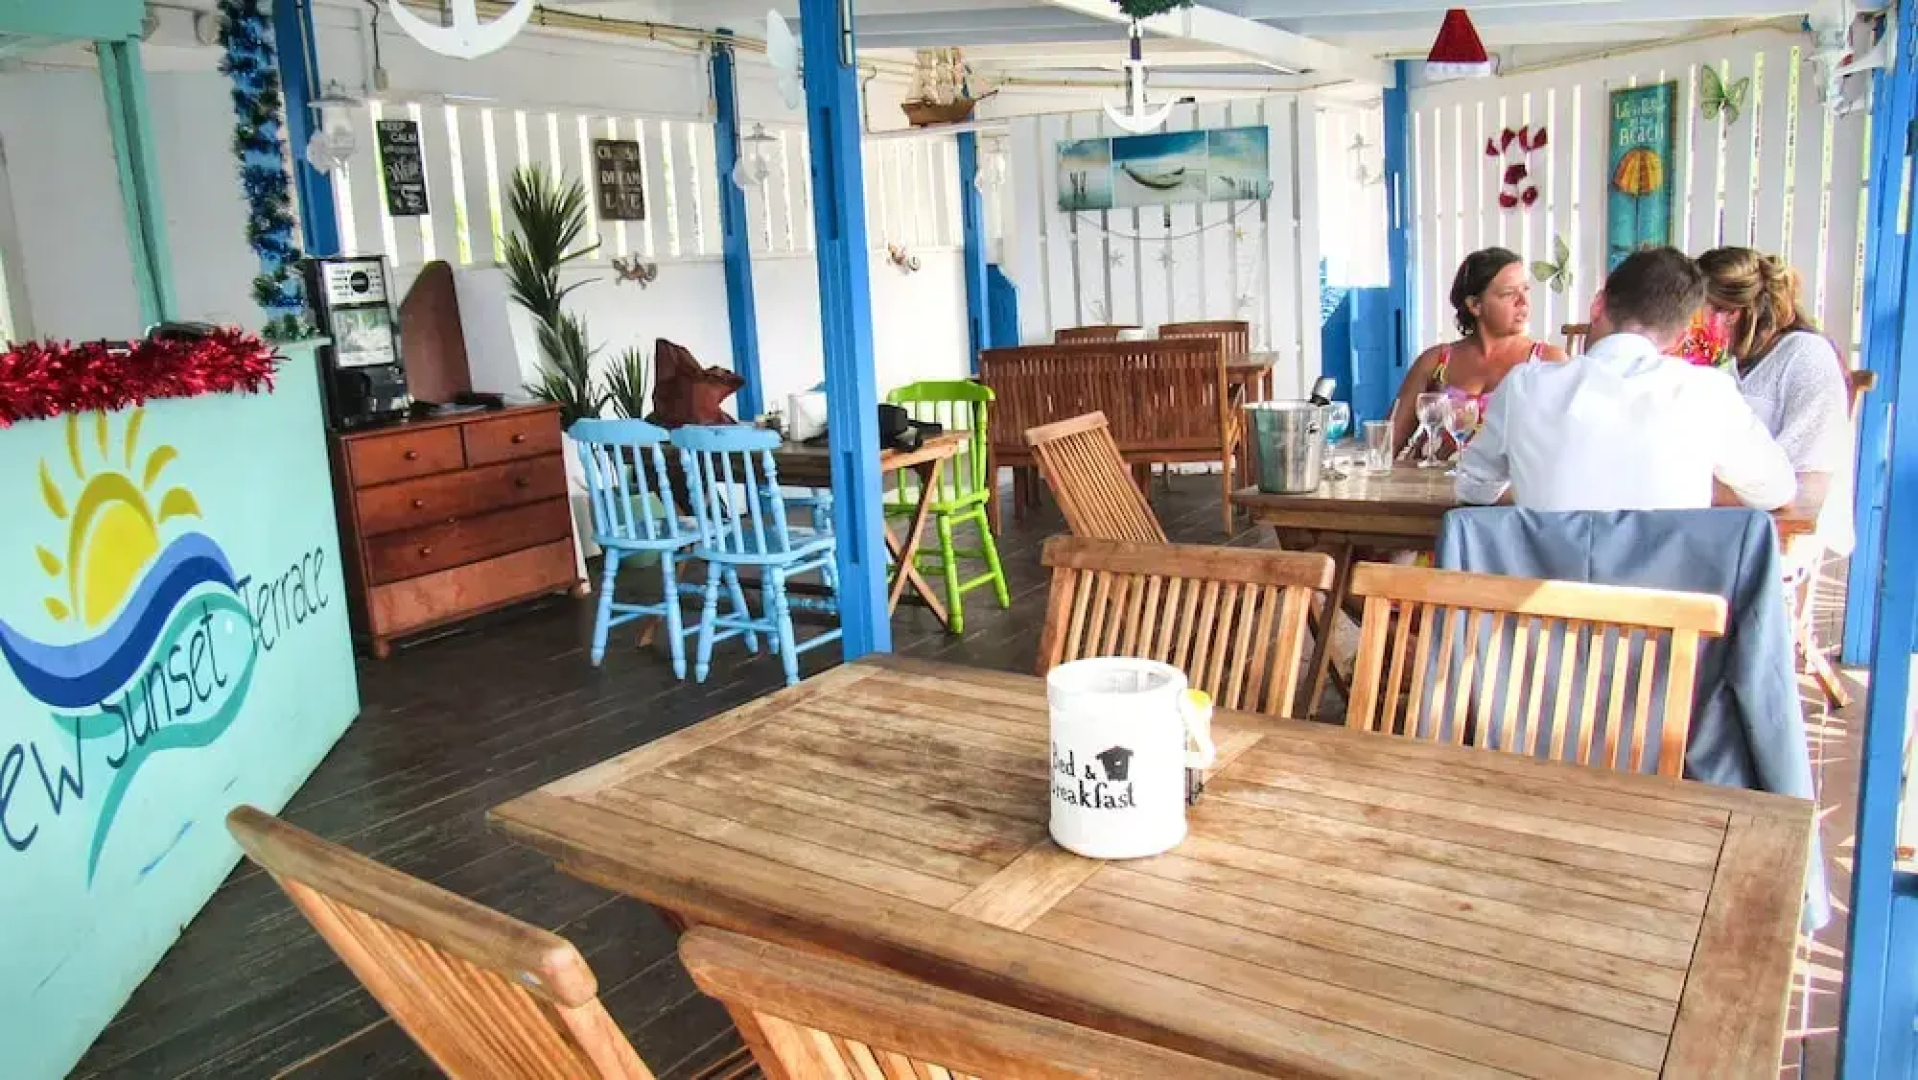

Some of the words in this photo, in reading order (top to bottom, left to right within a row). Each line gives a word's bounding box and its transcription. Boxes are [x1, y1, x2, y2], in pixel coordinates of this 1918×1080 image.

[236, 547, 329, 655] Terrace
[1085, 765, 1097, 779] &
[1053, 779, 1137, 809] reakfast
